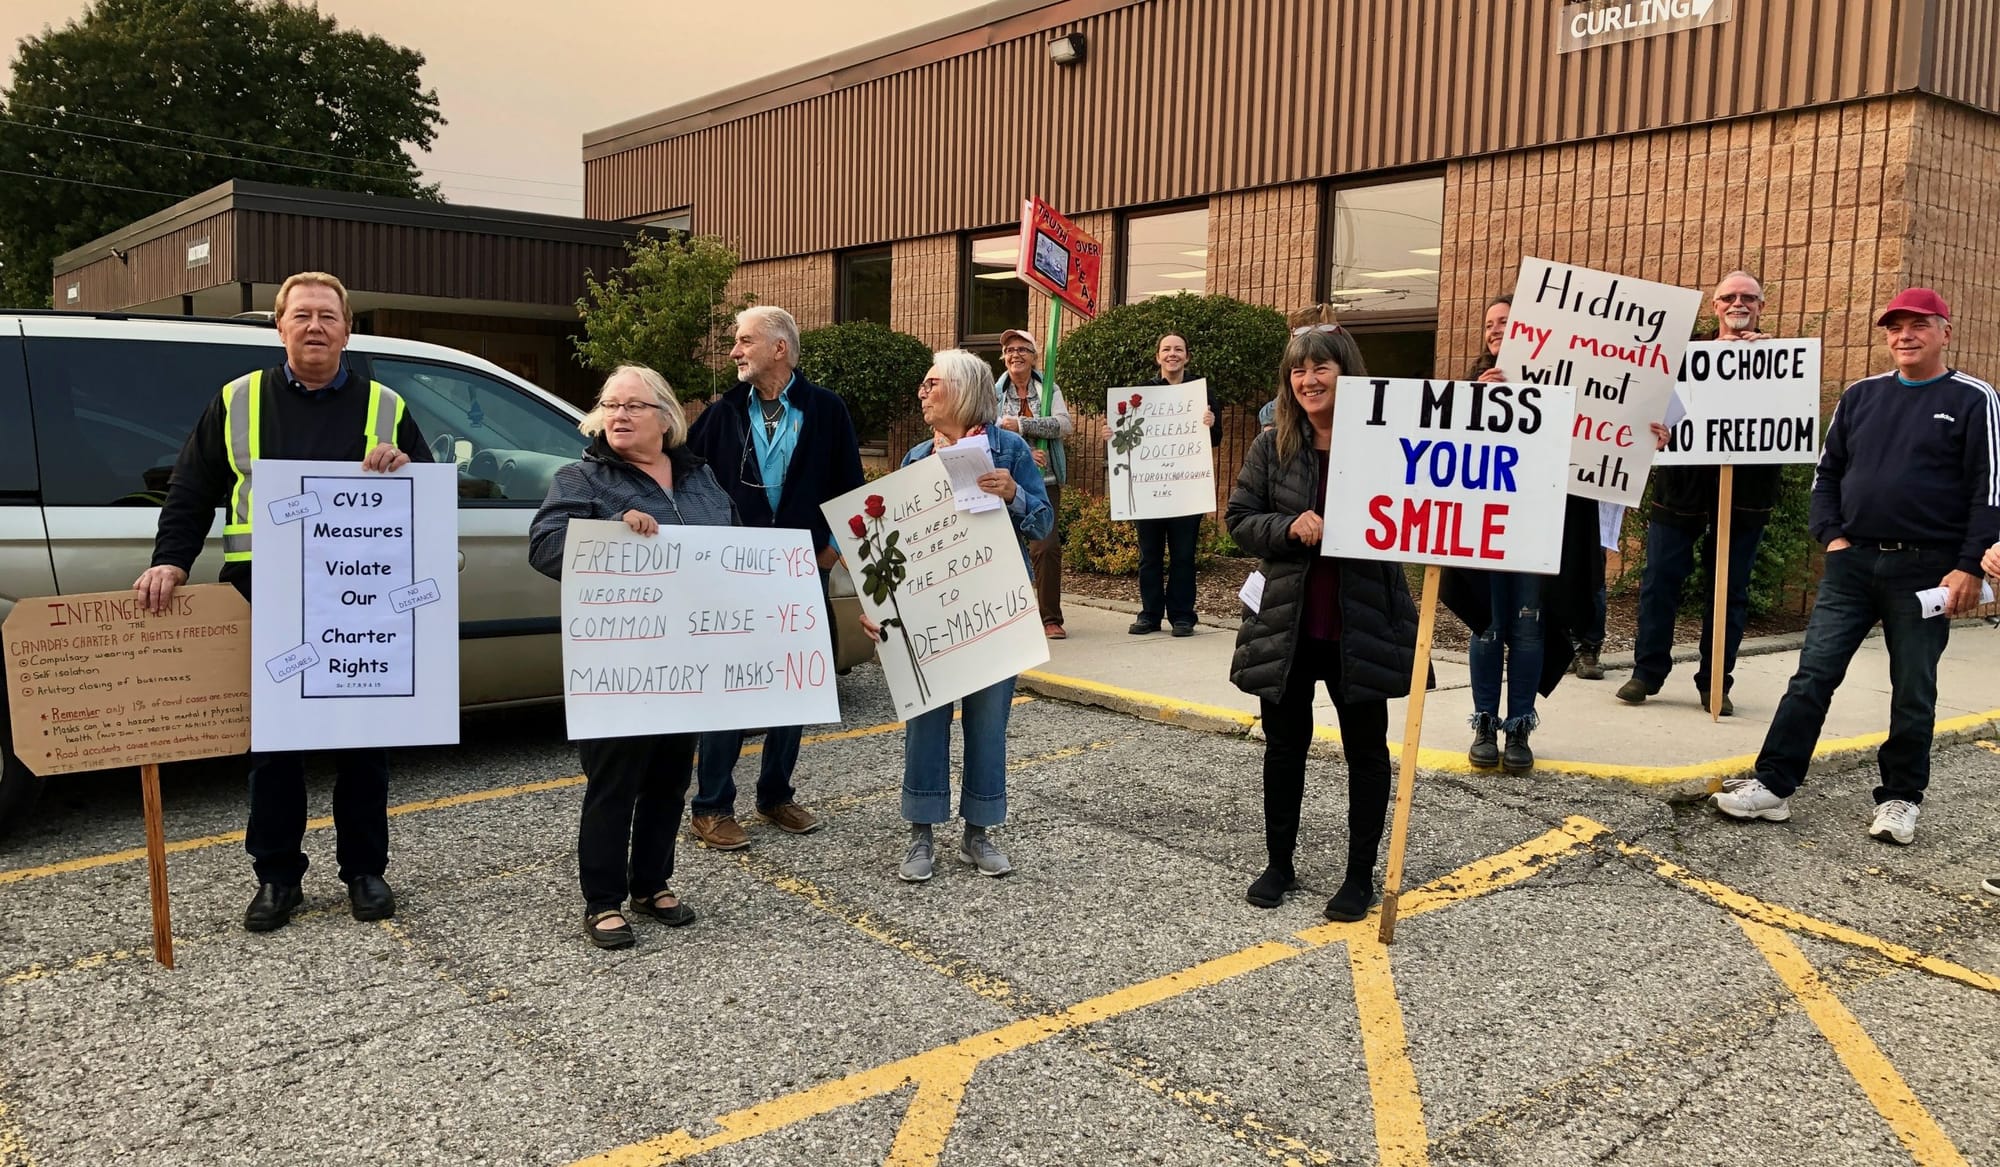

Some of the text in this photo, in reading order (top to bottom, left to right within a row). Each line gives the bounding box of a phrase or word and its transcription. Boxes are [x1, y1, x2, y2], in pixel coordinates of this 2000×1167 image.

[1571, 0, 1689, 38] CURLING
[1039, 204, 1068, 243] TRUTH
[1075, 240, 1098, 256] OVER
[1536, 267, 1667, 343] Hiding
[1510, 321, 1670, 374] my mouth
[1716, 347, 1807, 381] CHOICE
[1521, 359, 1640, 404] will not
[1143, 400, 1194, 417] PLEASE
[1366, 379, 1542, 434] I MISS
[1145, 420, 1198, 437] RELEASE
[1572, 413, 1634, 448] nce
[1706, 416, 1815, 453] FREEDOM
[1140, 441, 1202, 460] DOCTORS
[1399, 437, 1519, 492] YOUR
[288, 500, 300, 508] NO
[333, 492, 383, 508] CV19
[893, 479, 954, 521] LIKE SA
[284, 507, 310, 517] MASKS
[313, 523, 403, 538] Measures
[905, 514, 957, 544] WE NEED
[1365, 494, 1510, 560] SMILE
[910, 528, 968, 561] TO BE ON
[571, 540, 682, 573] FREEDOM
[695, 550, 712, 561] OF
[325, 560, 392, 576] Violate
[906, 546, 993, 594] THE ROAD
[341, 590, 377, 606] Our
[398, 591, 434, 609] DISTANCE
[407, 587, 419, 596] NO
[578, 586, 664, 602] INFORMED
[939, 589, 960, 607] TO
[128, 621, 146, 629] THE
[569, 615, 666, 639] COMMON
[688, 608, 755, 634] SENSE
[913, 585, 1028, 660] DE-MASK-US
[10, 637, 69, 657] CANADA'S
[72, 633, 118, 649] CHARTER
[123, 633, 135, 642] OF
[141, 630, 173, 642] RIGHTS
[183, 624, 239, 639] FREEDOMS
[321, 628, 397, 644] Charter
[138, 647, 150, 655] of
[153, 645, 183, 654] masks
[284, 653, 297, 663] NO
[33, 667, 100, 680] Self isolation
[278, 656, 313, 677] CLOSURES
[329, 658, 389, 678] Rights
[569, 663, 710, 693] MANDATORY
[51, 706, 101, 722] Remember
[106, 703, 125, 716] only
[132, 700, 146, 712] 1%
[152, 698, 161, 708] of
[53, 724, 80, 736] Masks
[210, 703, 243, 718] physical
[65, 733, 93, 744] health
[55, 745, 79, 760] Road
